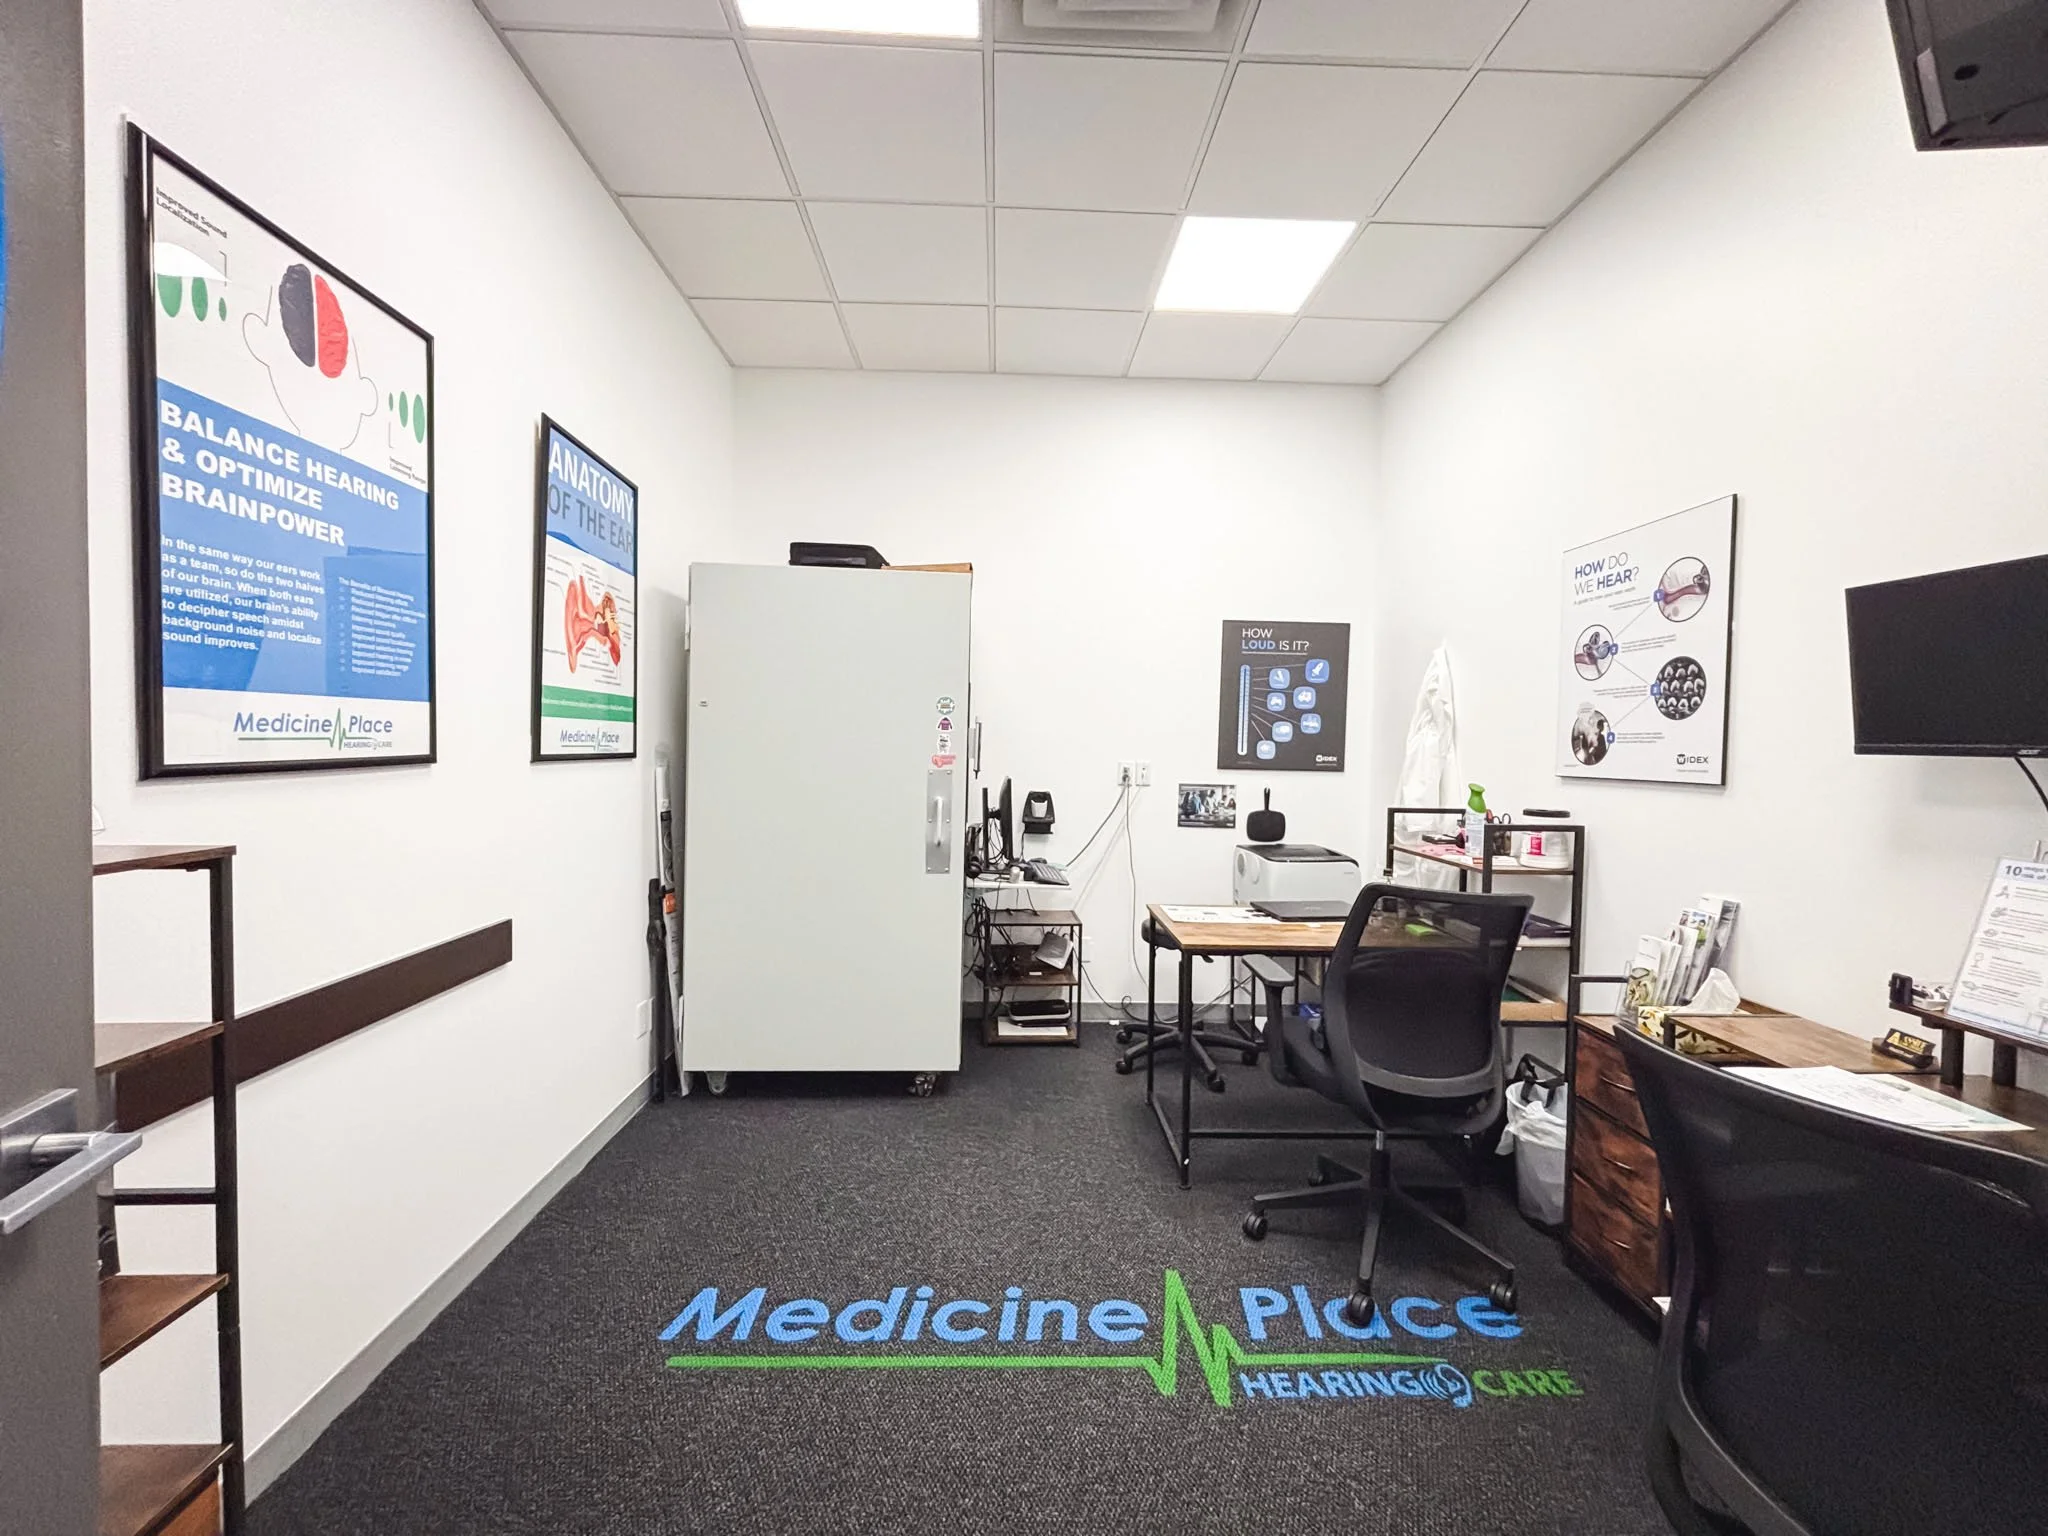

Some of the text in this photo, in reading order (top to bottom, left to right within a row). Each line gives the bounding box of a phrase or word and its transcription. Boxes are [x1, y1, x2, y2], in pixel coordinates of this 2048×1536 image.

[156, 188, 227, 238] Improved Sound
[156, 197, 209, 236] Localization
[160, 400, 399, 510] BALANCE HEARING
[162, 437, 323, 511] & OPTIMIZE
[548, 440, 634, 523] ANATOMY
[161, 472, 345, 546] BRAINPOWER
[548, 484, 633, 553] OF THE EAR
[161, 534, 321, 580] In the same way our ears work
[161, 553, 325, 594] as a team, so do the two halves
[1575, 552, 1628, 580] HOW DO
[162, 568, 314, 605] of our brain. When both ears
[1574, 578, 1594, 596] WE
[1597, 566, 1640, 590] HEAR?
[162, 584, 319, 620] are utilized, our brain's ability
[162, 598, 304, 629] to decipher speech amidst
[162, 613, 322, 644] background noise and localize
[162, 631, 259, 651] sound improves.
[1241, 640, 1310, 651] LOUD IS IT?
[1242, 628, 1273, 638] HOW
[233, 712, 393, 733] Medicine Place
[560, 729, 620, 743] Medicine Place
[2005, 865, 2022, 876] 10
[657, 1284, 1524, 1342] Medicine Place
[1238, 1369, 1585, 1400] HEARING CARE
